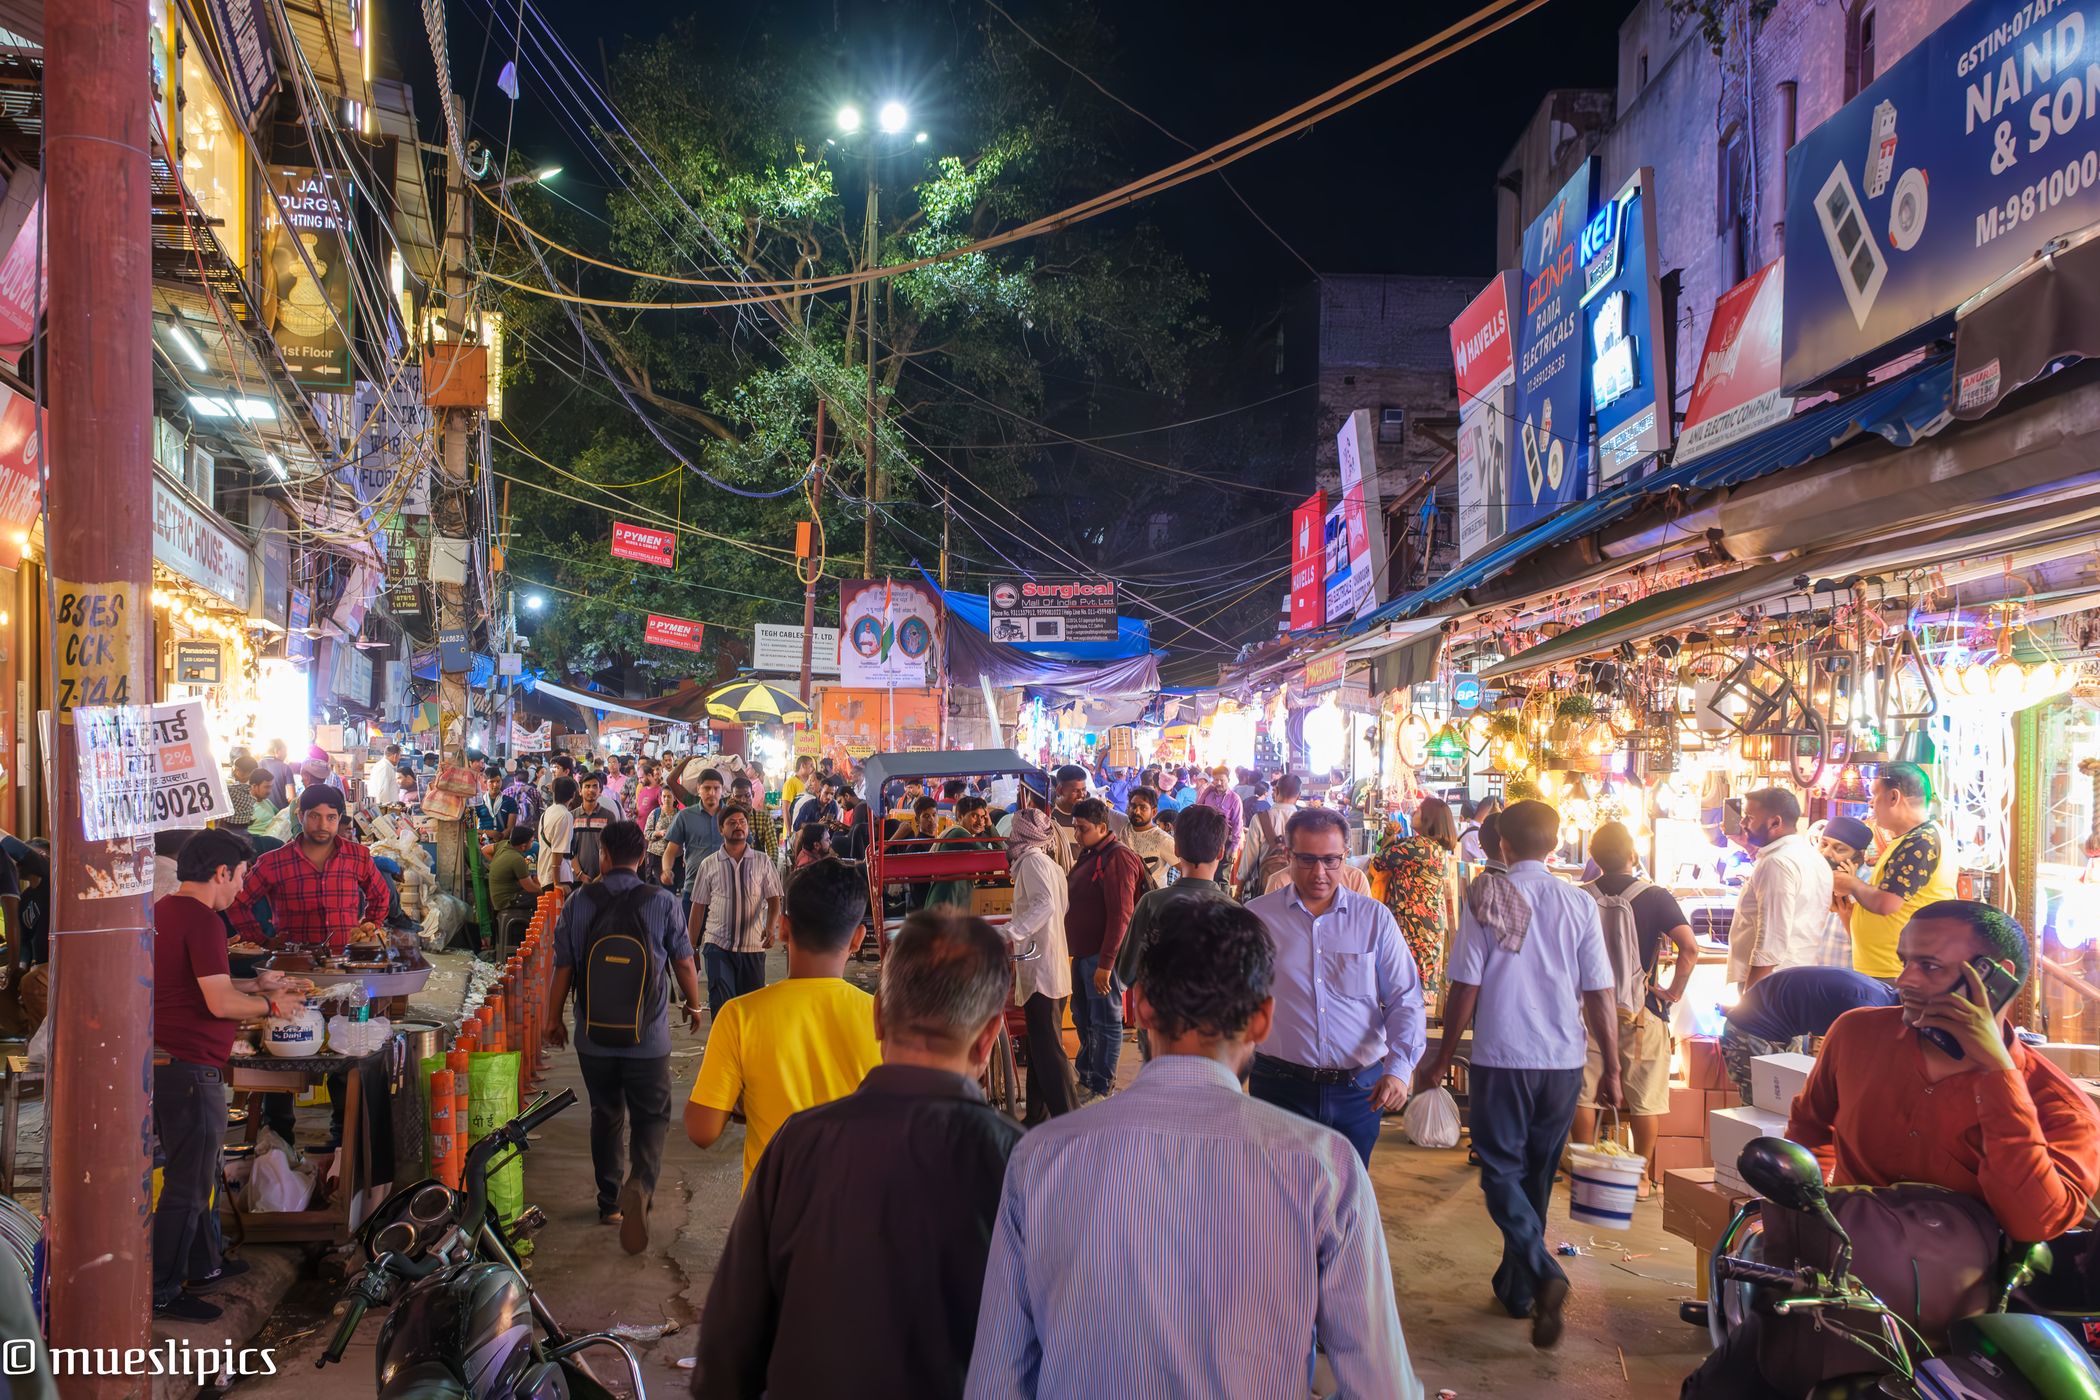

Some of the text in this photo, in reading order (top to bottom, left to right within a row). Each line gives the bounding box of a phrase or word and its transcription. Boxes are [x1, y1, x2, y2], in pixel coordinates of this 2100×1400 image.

[1966, 11, 2085, 136] NAND
[1990, 120, 2018, 176] &
[297, 179, 325, 194] JAI
[1976, 150, 2100, 248] M:981000
[273, 212, 323, 229] LIHTING
[1580, 201, 1613, 268] KEI
[1536, 296, 1561, 337] RAMA
[281, 344, 334, 358] 1st Floor
[1467, 309, 1506, 364] HAVELLS
[1522, 311, 1575, 375] ELECTRICALS
[1704, 404, 1737, 440] ELECTRIC
[195, 522, 223, 576] HOUSE
[624, 531, 662, 546] PYMEN
[1022, 582, 1114, 599] Surgical
[1293, 564, 1315, 592] HAVELLS
[57, 593, 125, 628] BSES
[1022, 599, 1040, 607] Mall
[1043, 599, 1055, 607] Of
[1056, 599, 1077, 607] India
[656, 621, 691, 634] PYMEN
[779, 631, 804, 639] CABLES
[66, 633, 114, 668] CCK
[180, 646, 219, 655] Panasonic
[164, 749, 192, 768] 2%
